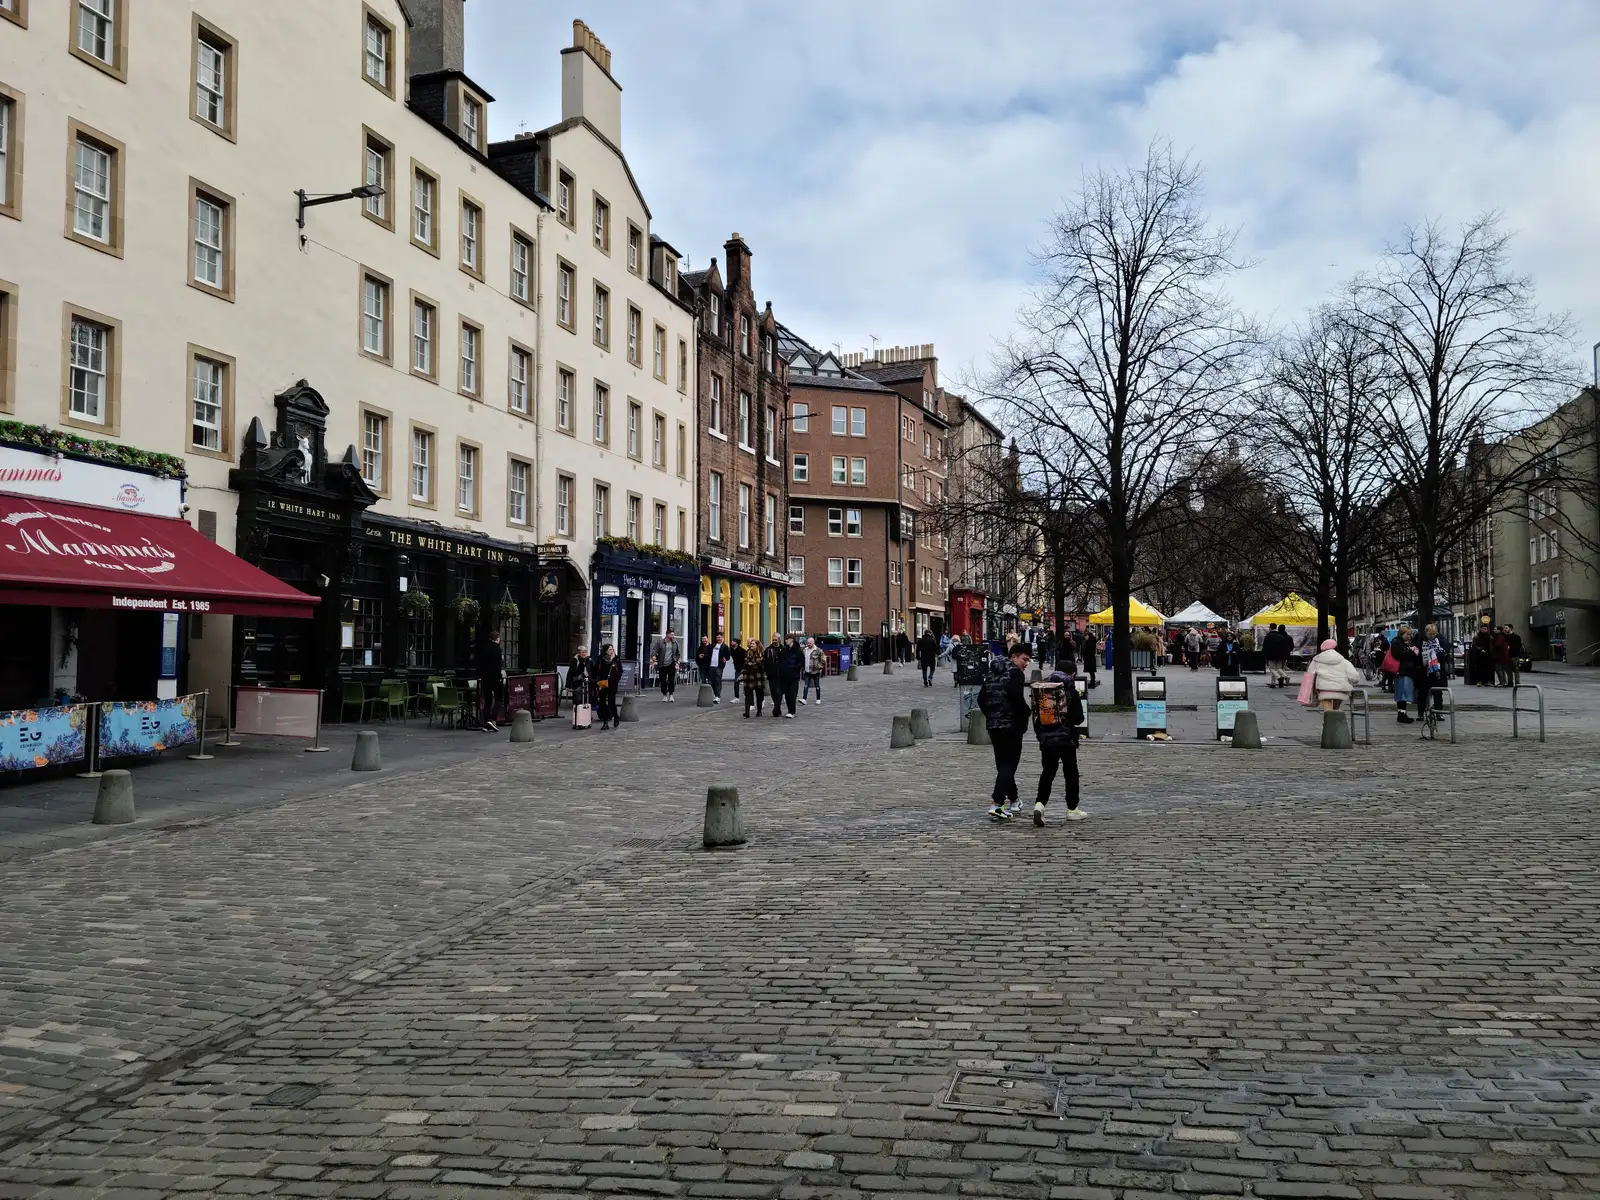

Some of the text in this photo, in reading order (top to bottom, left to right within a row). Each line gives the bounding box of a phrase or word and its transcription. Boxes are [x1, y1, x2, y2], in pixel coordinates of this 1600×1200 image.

[279, 502, 304, 514] WHITE
[306, 507, 326, 518] HART
[328, 512, 341, 521] INN
[390, 531, 504, 562] THE WHITE HART INN
[623, 573, 636, 586] Petit
[112, 596, 210, 611] Independent Est. 1985
